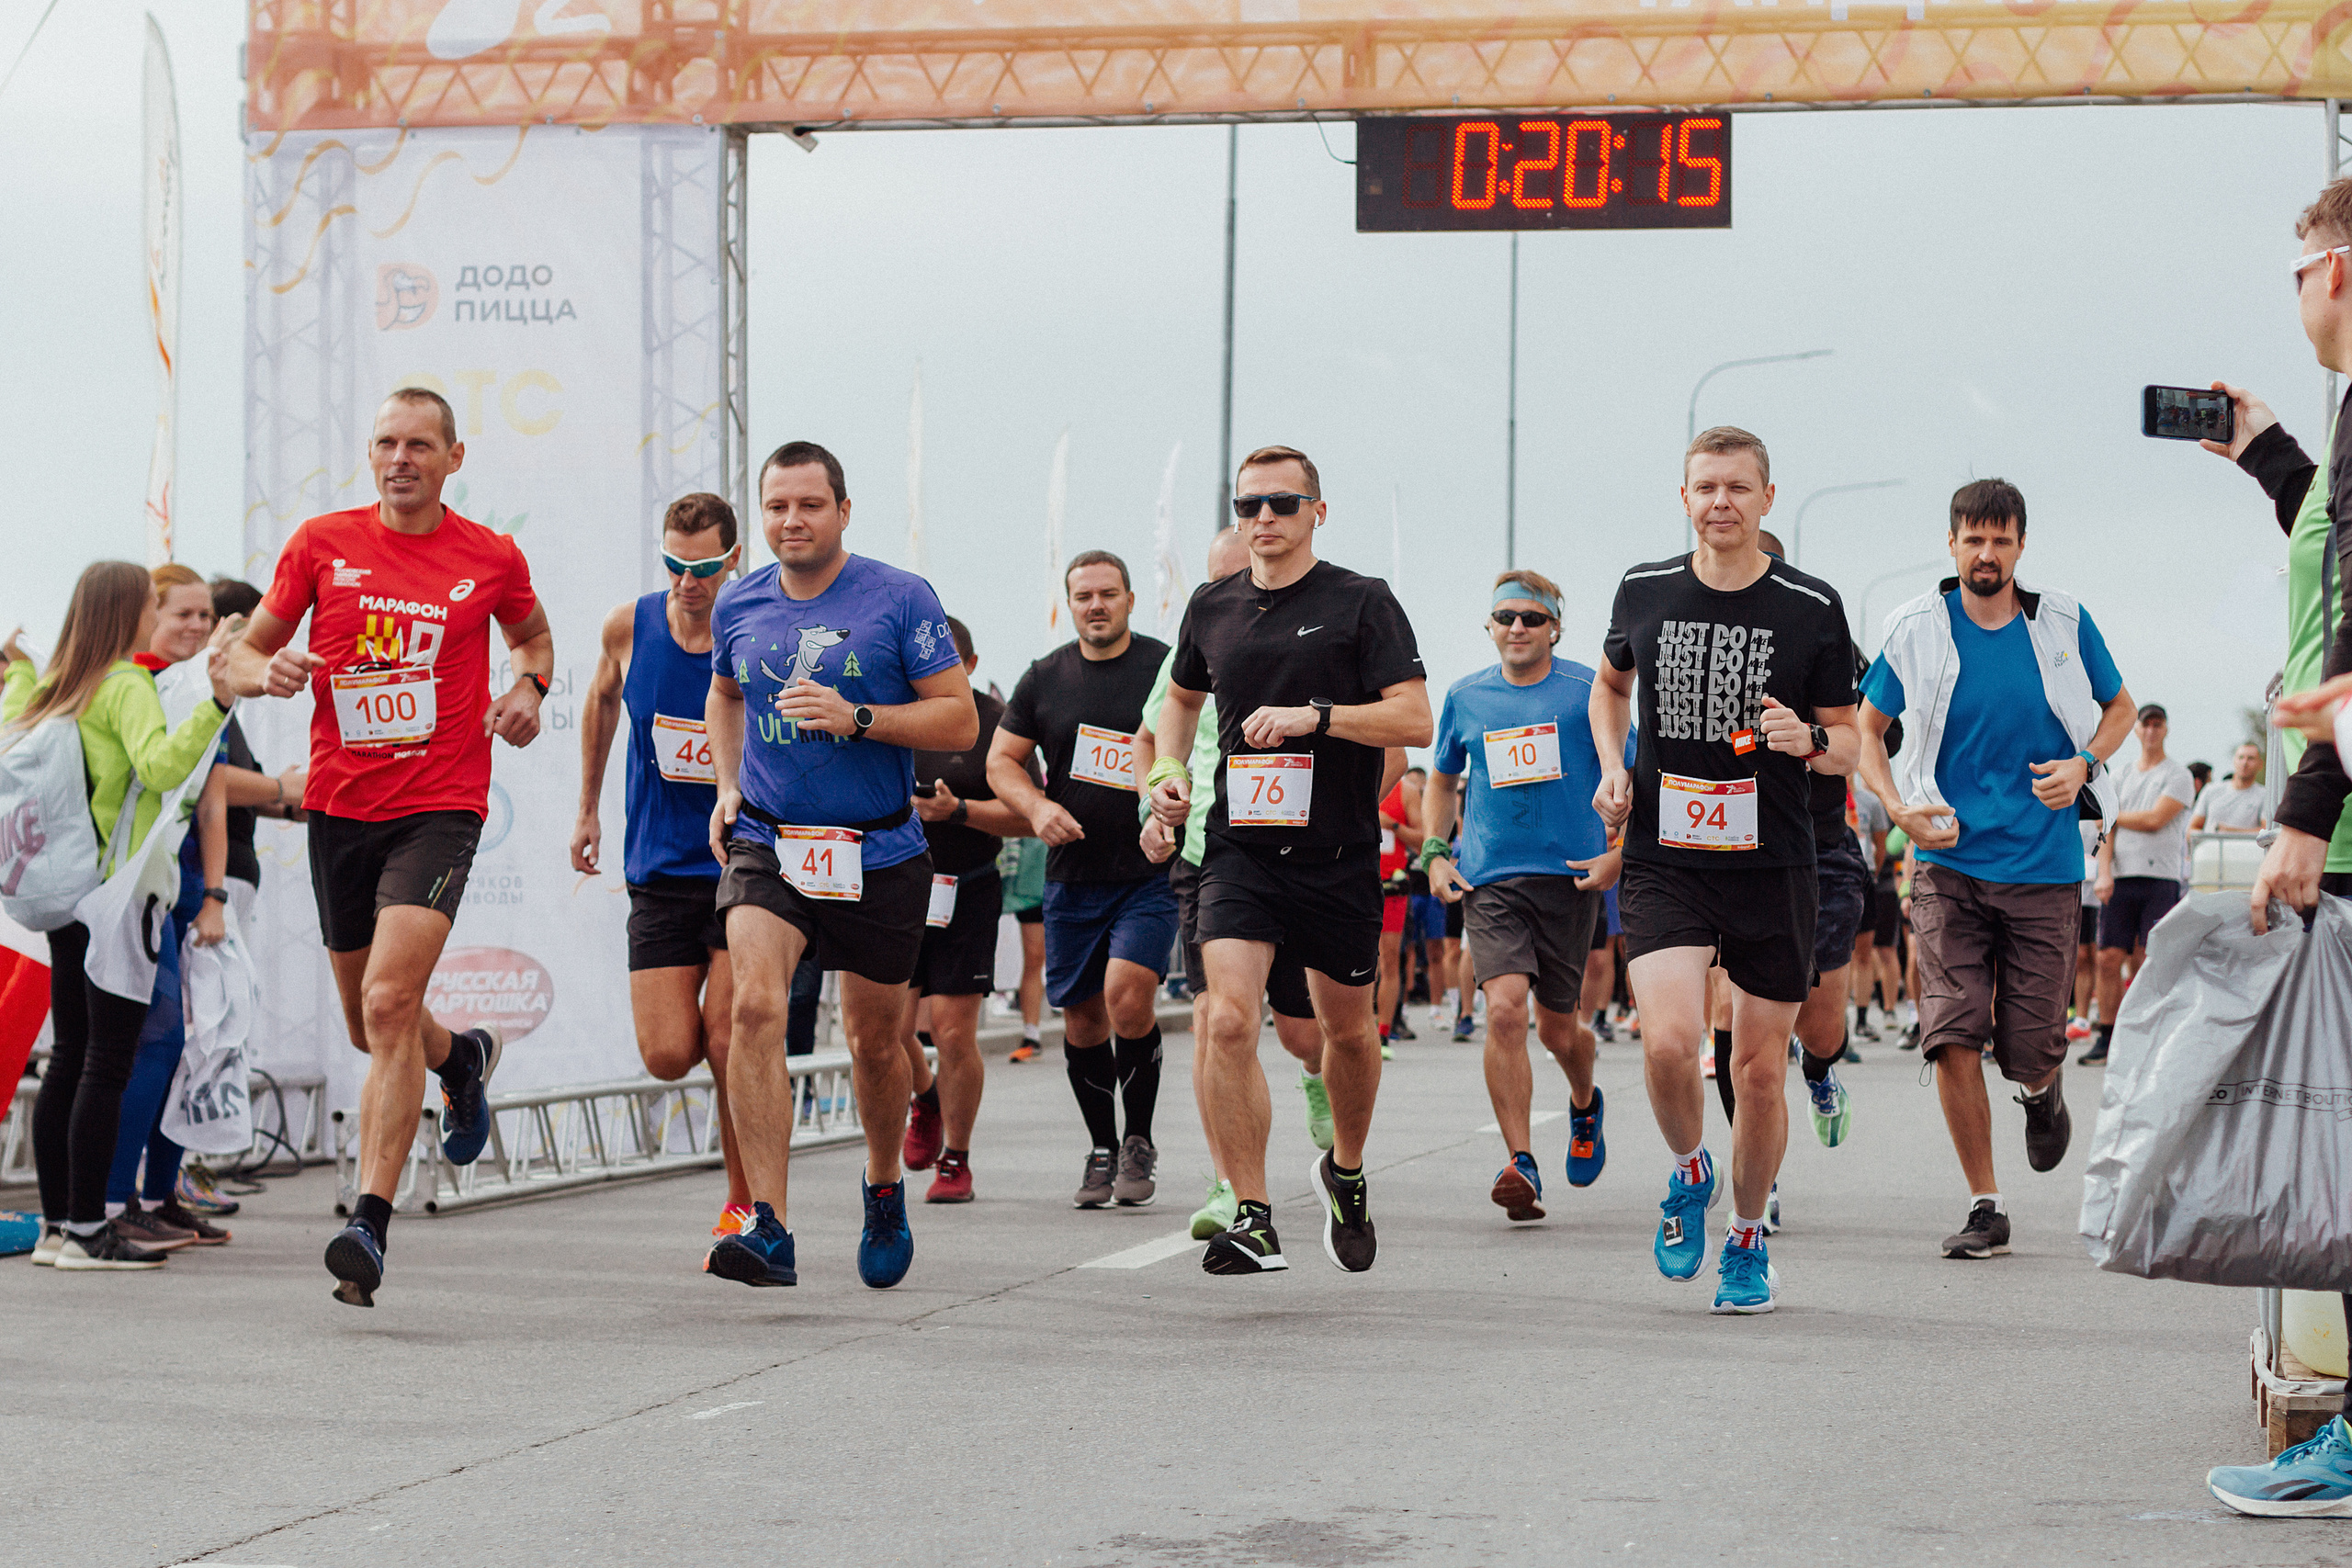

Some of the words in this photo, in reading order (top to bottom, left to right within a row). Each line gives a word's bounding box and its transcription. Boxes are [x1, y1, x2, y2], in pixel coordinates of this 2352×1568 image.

[1452, 118, 1723, 210] 0:20:15
[455, 265, 553, 292] ДОДО
[455, 299, 577, 326] ПИЦЦА
[358, 594, 448, 621] МАРАФОН
[1657, 620, 1711, 646] JUST
[1712, 623, 1747, 649] DO
[1749, 627, 1775, 654] IT.
[1655, 643, 1707, 670] JUST
[1709, 647, 1745, 673] DO
[1747, 650, 1772, 678] IT.
[1654, 667, 1705, 693] JUST
[1707, 670, 1742, 696] DO
[355, 691, 417, 725] 100
[1657, 690, 1704, 716] JUST
[1706, 694, 1741, 719] DO
[1743, 698, 1762, 720] IT
[1657, 714, 1702, 740] JUST
[1705, 717, 1740, 743] DO
[1735, 734, 1752, 749] NIKE
[675, 739, 713, 766] 46
[1091, 745, 1134, 773] 102
[1508, 742, 1536, 767] 10
[1250, 775, 1284, 805] 76
[1668, 779, 1714, 792] ПОЛУМАРАФОН
[1686, 799, 1728, 830] 94
[801, 847, 832, 877] 41
[429, 968, 540, 992] РУССКАЯ
[2241, 1084, 2301, 1100] INTERNET
